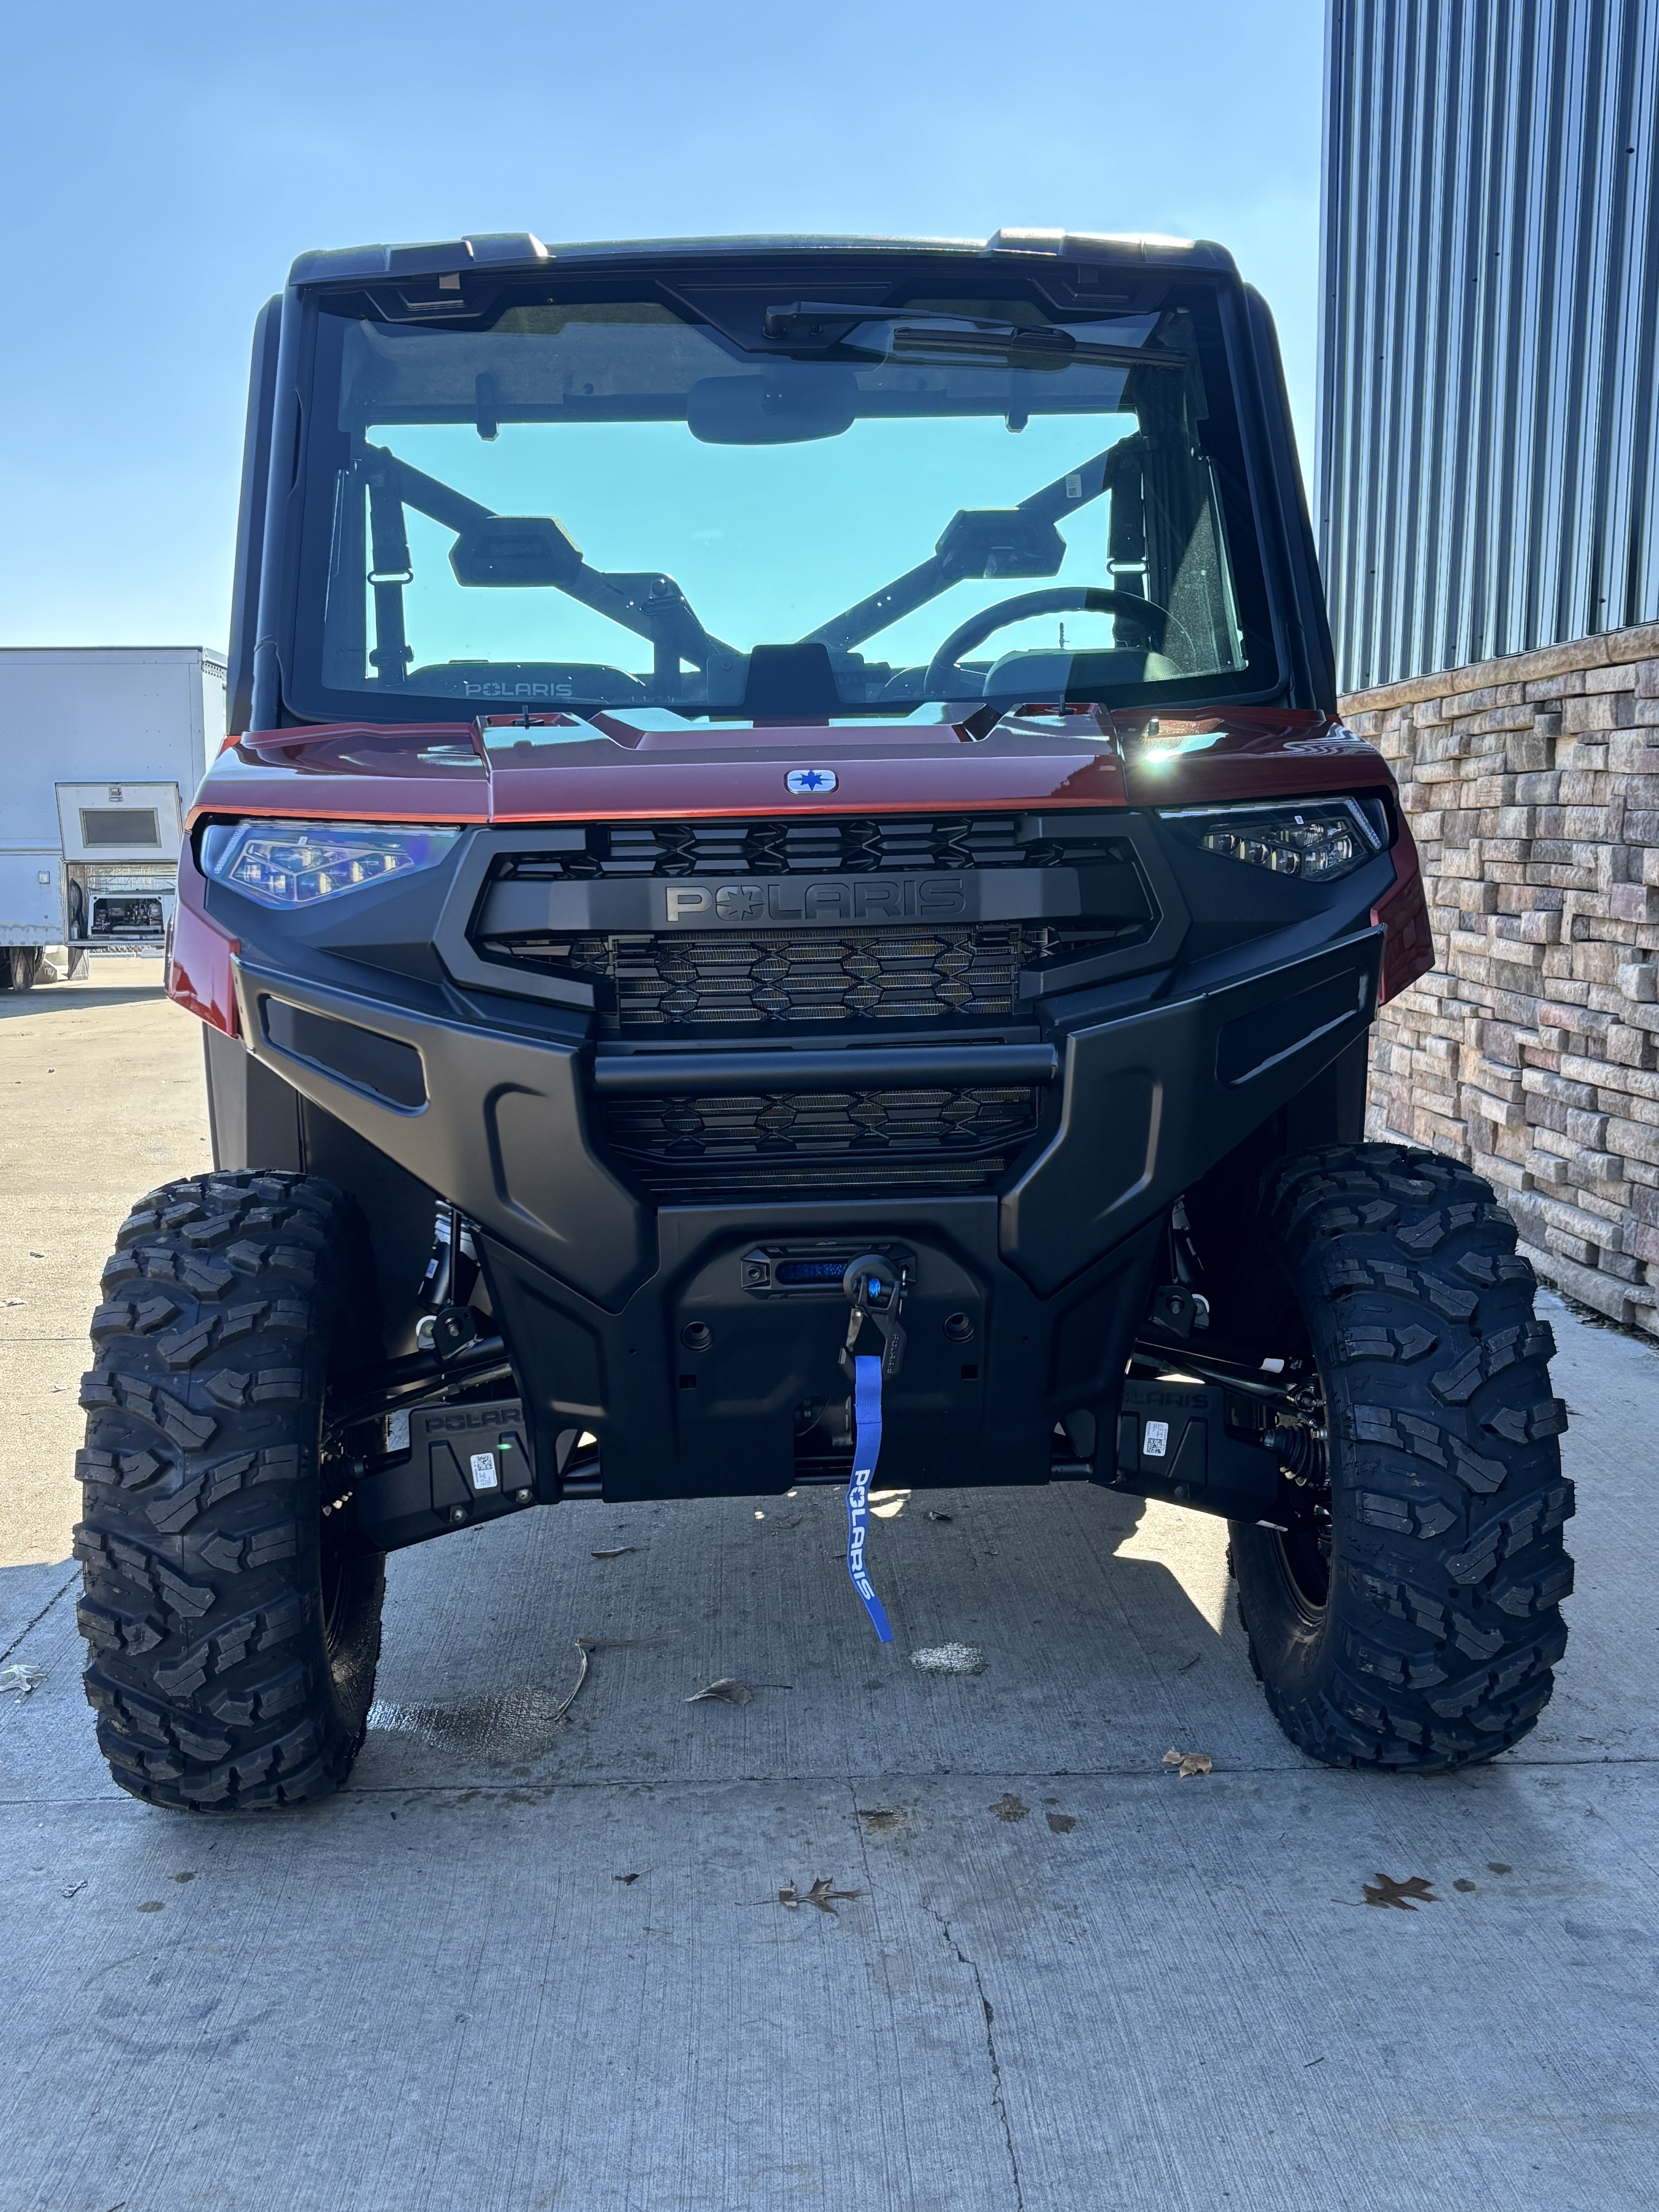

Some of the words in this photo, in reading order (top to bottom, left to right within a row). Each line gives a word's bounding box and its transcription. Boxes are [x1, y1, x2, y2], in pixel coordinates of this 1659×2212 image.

[465, 683, 572, 697] POLARIS
[666, 879, 966, 922] POLARIS
[1124, 1389, 1209, 1408] LARIS
[426, 1409, 521, 1432] POLAR
[850, 1469, 874, 1600] POLARIS
